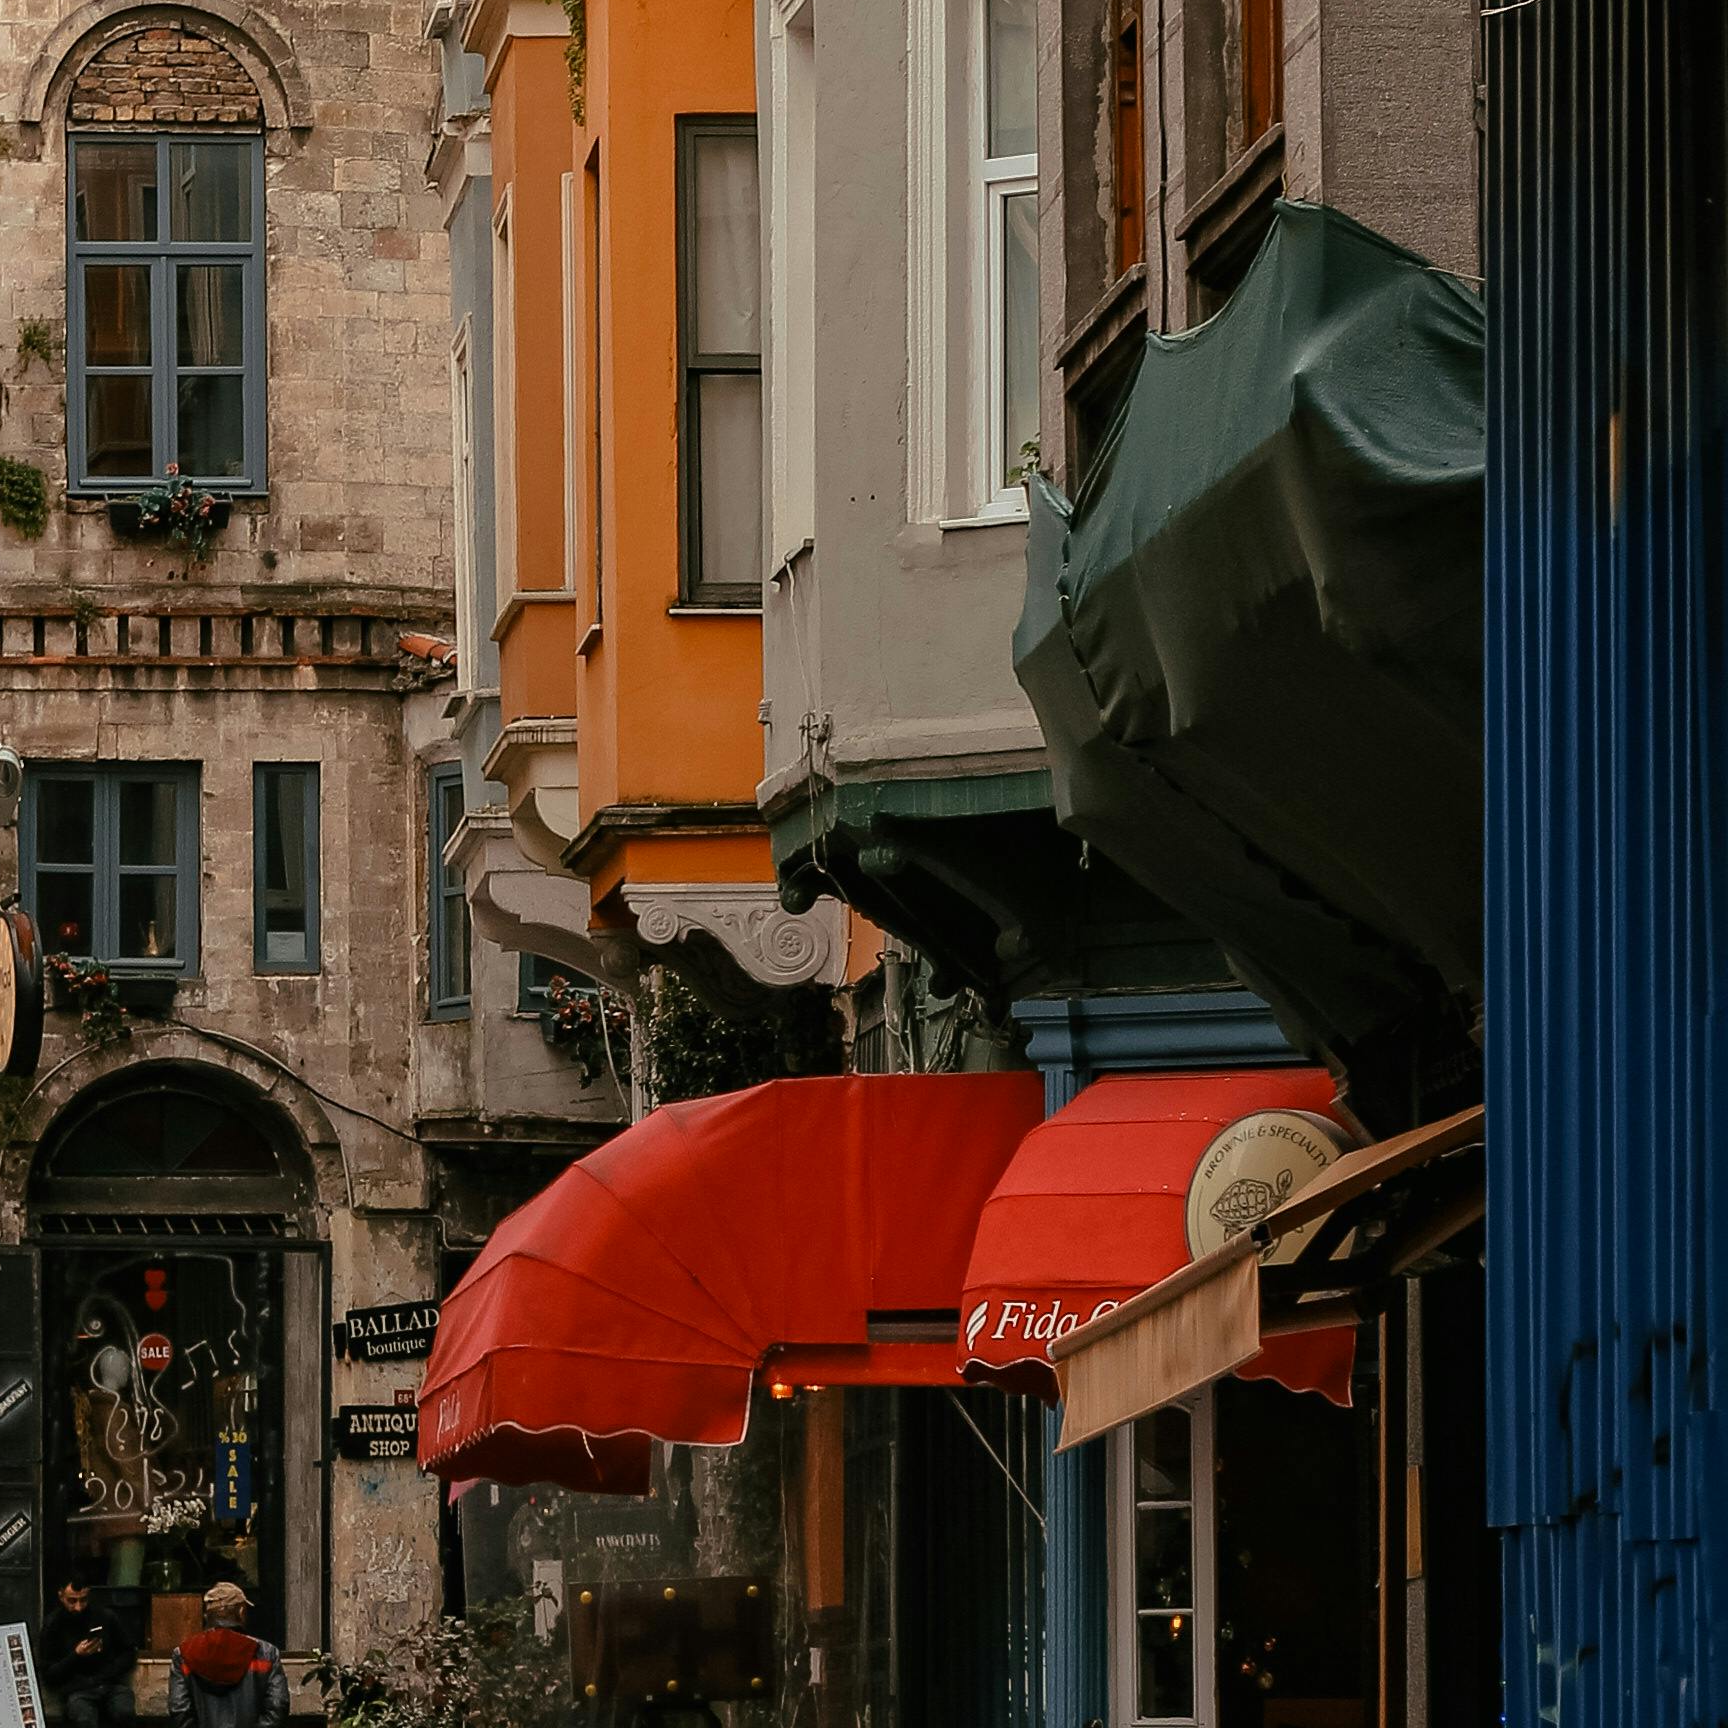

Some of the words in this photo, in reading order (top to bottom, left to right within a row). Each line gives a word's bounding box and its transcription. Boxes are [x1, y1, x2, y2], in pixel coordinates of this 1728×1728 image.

[1204, 1127, 1256, 1179] BROWNIE
[1257, 1125, 1267, 1137] &
[1269, 1124, 1331, 1168] SPECIALTY
[350, 1308, 440, 1339] BALLAD
[140, 1346, 170, 1359] SALE
[366, 1336, 427, 1356] boutique
[349, 1413, 417, 1433] ANTIQU
[369, 1440, 410, 1456] SHOP
[226, 1449, 239, 1509] SALE
